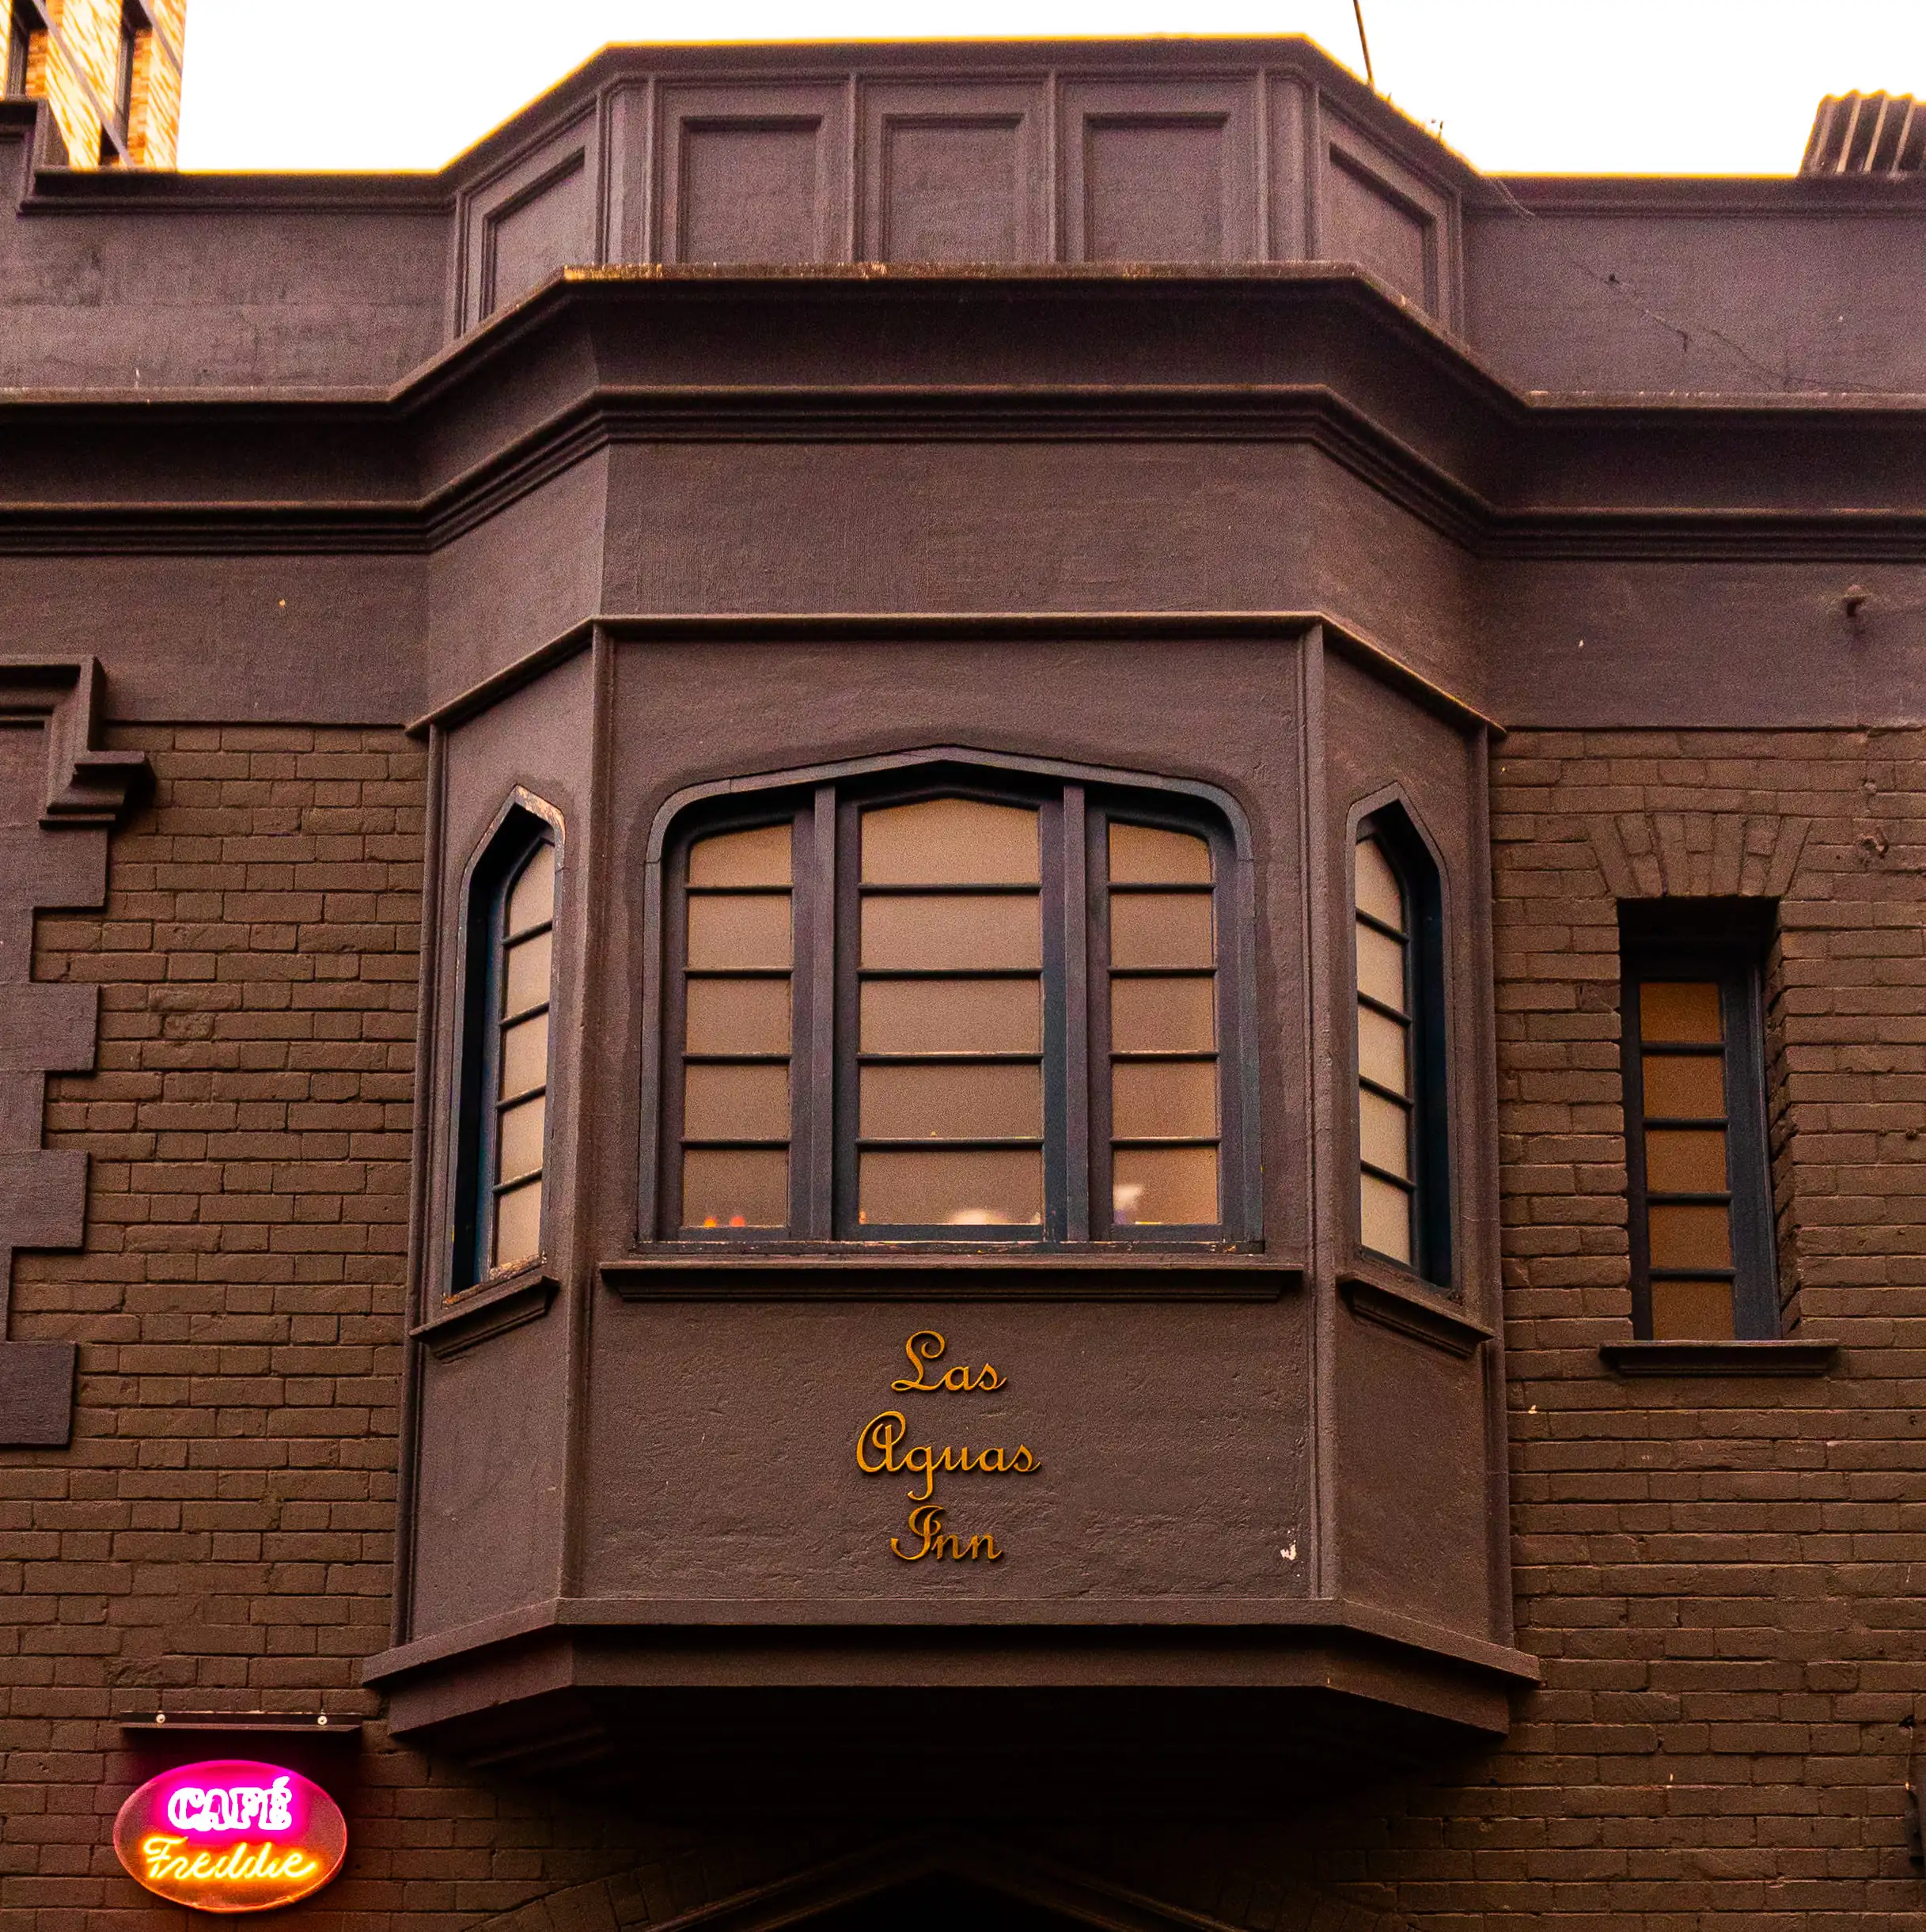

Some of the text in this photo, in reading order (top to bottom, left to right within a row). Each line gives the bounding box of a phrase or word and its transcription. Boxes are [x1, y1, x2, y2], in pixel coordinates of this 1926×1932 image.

[890, 1330, 1007, 1392] Las
[855, 1411, 1041, 1501] Aguas
[890, 1505, 1003, 1560] Inn
[167, 1775, 293, 1832] CAFÉ
[142, 1835, 317, 1880] Freddie
